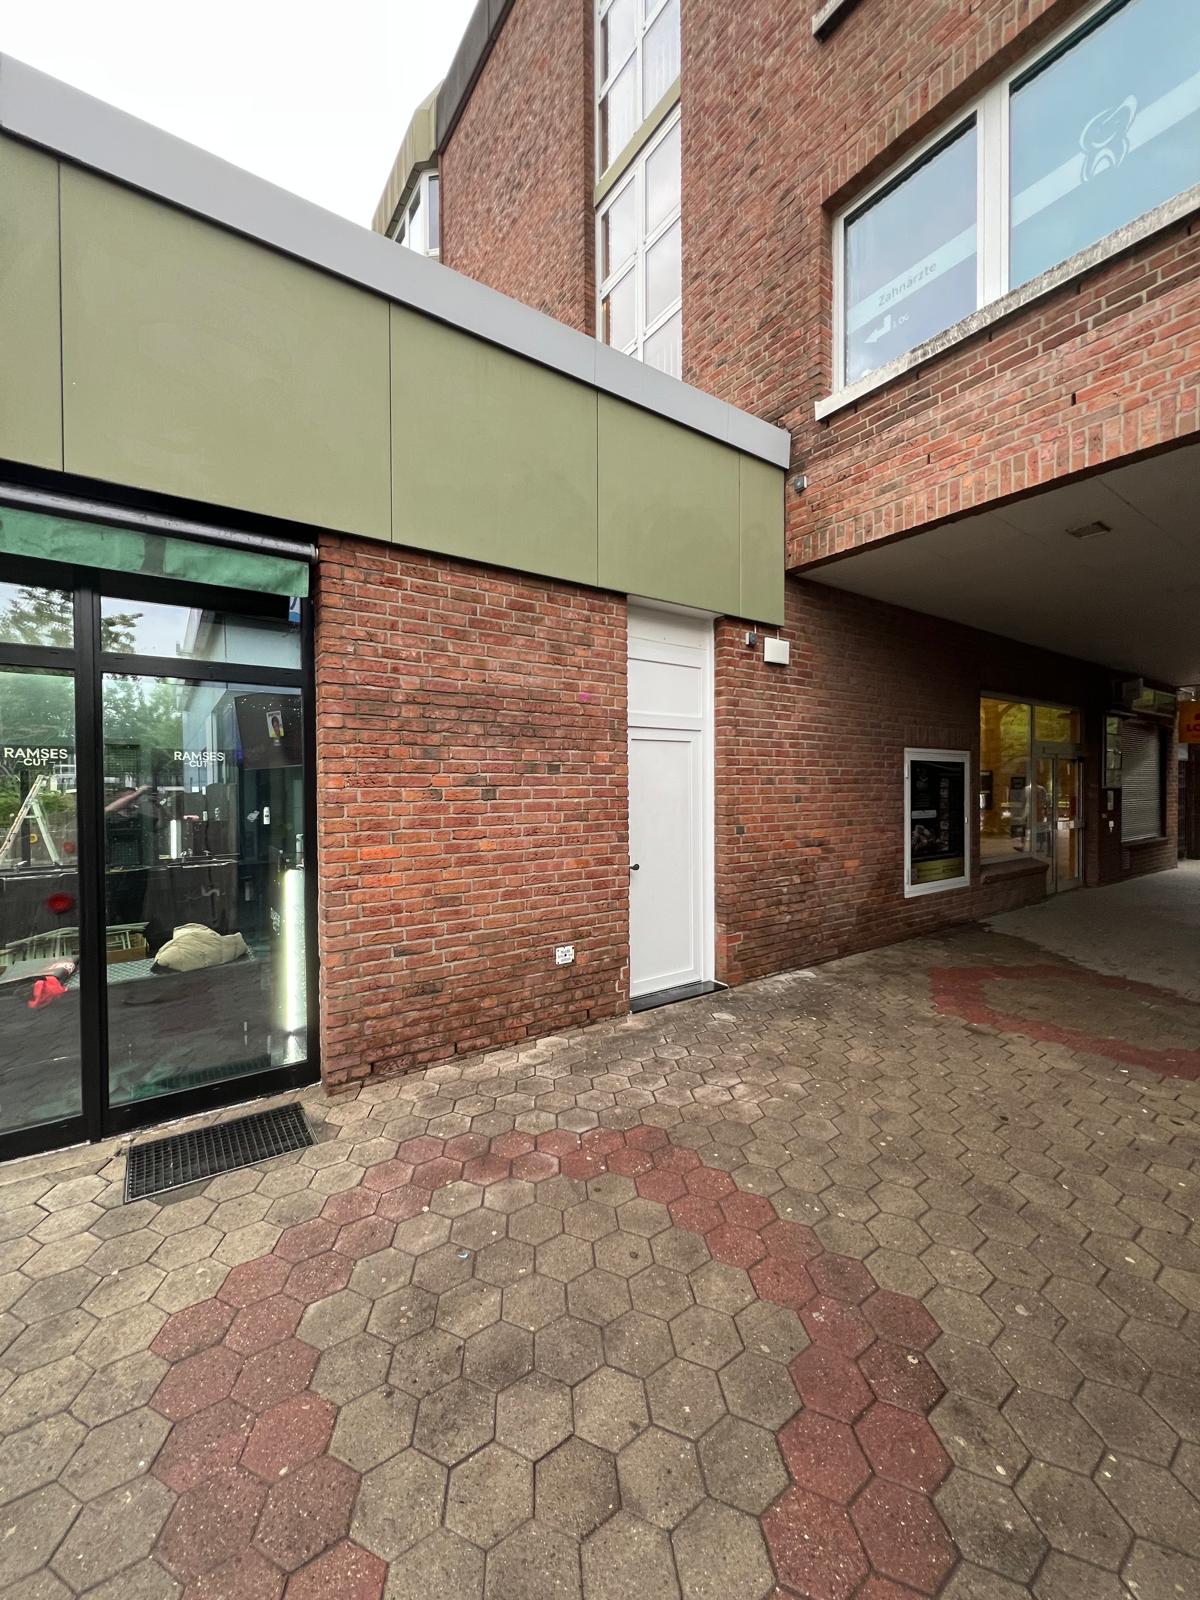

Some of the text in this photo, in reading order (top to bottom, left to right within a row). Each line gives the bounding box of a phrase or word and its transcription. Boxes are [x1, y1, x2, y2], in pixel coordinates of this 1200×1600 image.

[4, 747, 68, 759] RAMSES
[174, 751, 224, 762] RAMSES
[23, 758, 48, 767] CUT
[189, 760, 207, 768] CUT
